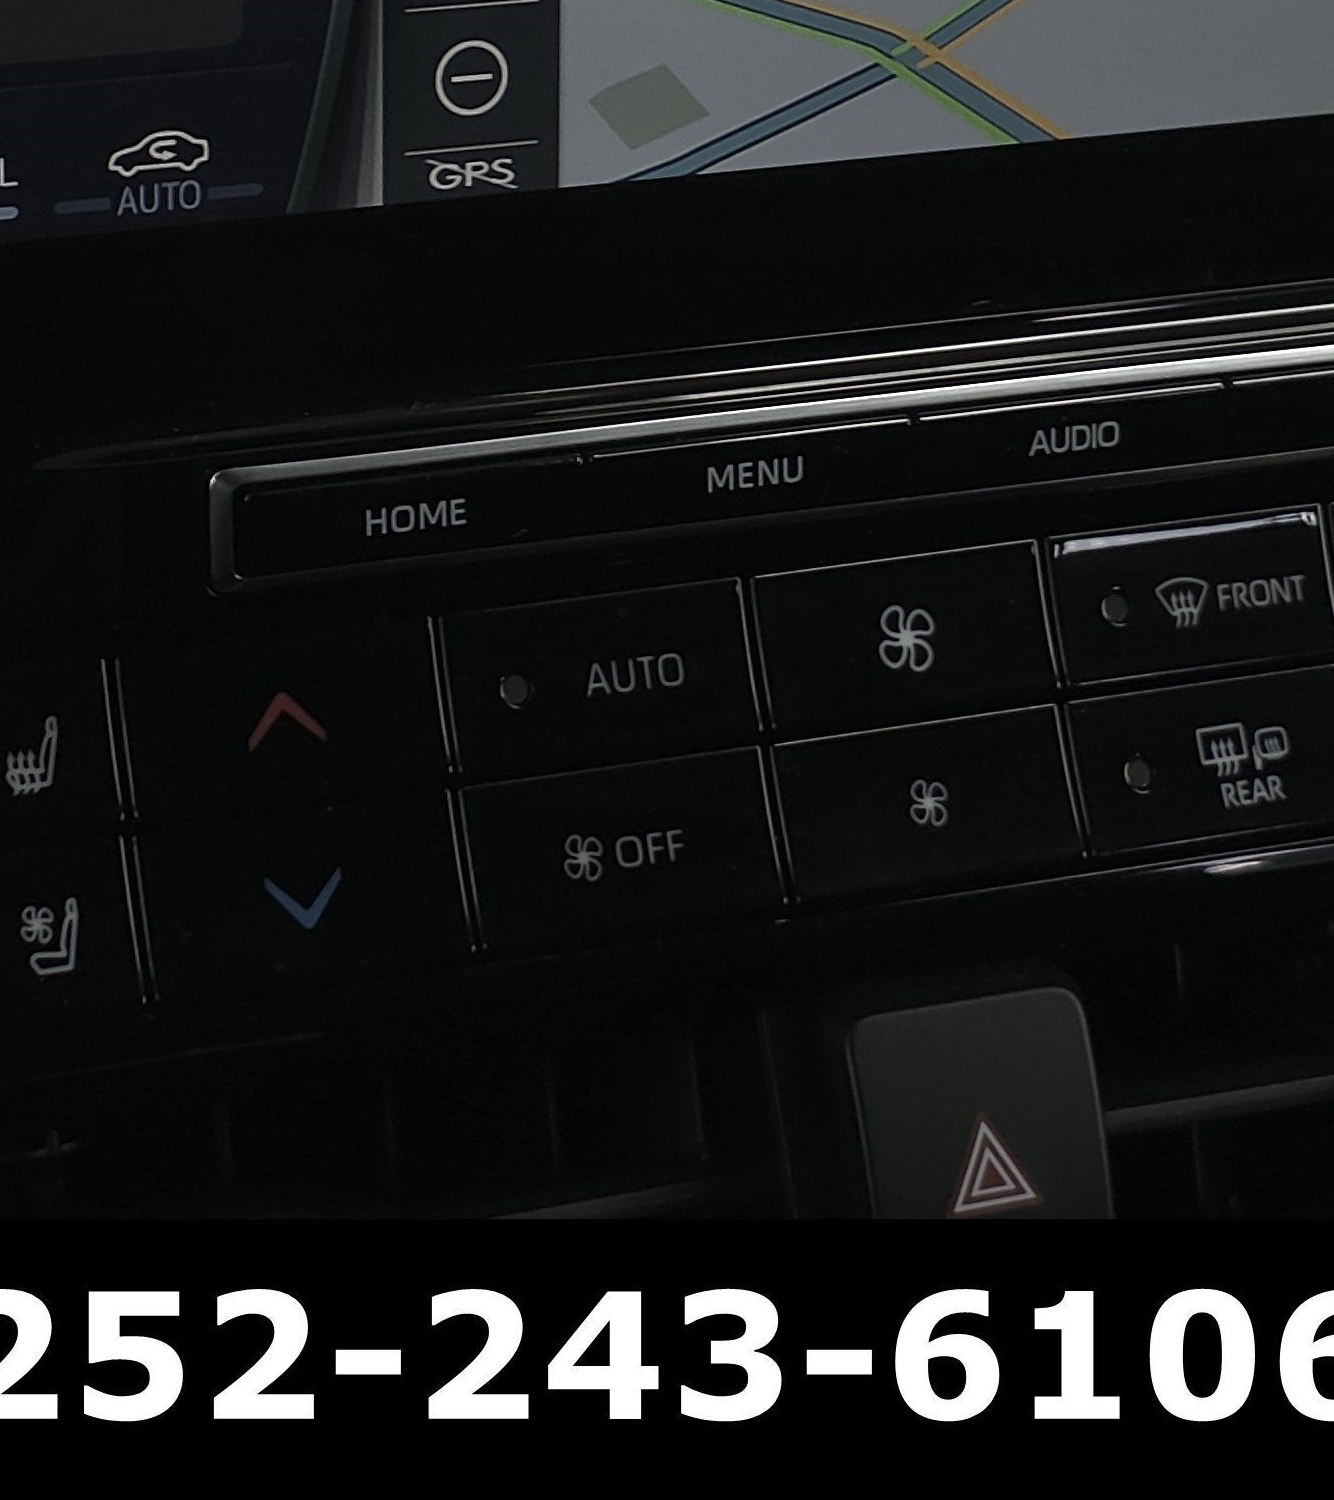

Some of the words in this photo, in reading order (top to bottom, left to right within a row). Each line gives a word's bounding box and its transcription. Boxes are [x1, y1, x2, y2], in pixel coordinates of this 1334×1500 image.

[116, 180, 201, 217] AUTO
[1028, 421, 1121, 457] AUDIO
[706, 456, 805, 493] MENU
[366, 498, 468, 536] HOME
[1217, 575, 1307, 611] FRONT
[586, 653, 685, 697] AUTO
[1220, 775, 1287, 809] REAR
[614, 830, 686, 868] OFF
